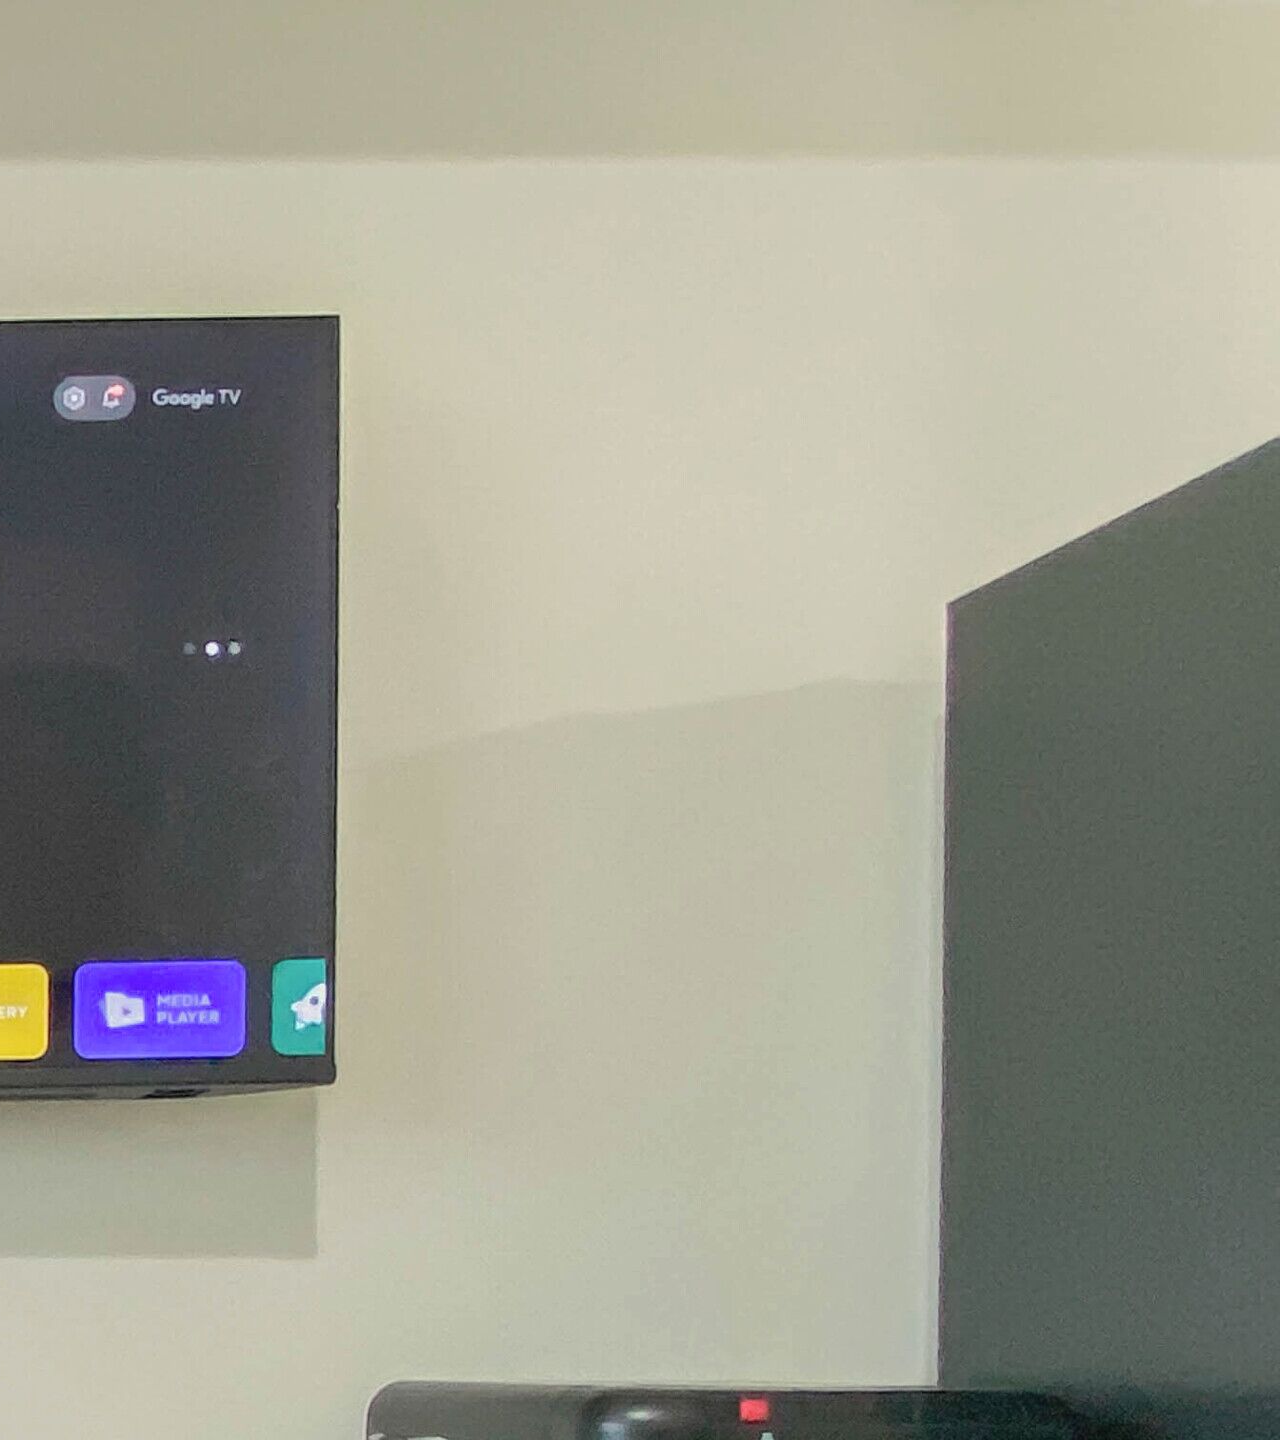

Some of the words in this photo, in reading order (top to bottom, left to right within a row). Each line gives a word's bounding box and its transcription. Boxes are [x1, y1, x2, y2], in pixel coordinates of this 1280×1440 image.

[152, 388, 214, 410] Google
[218, 388, 242, 405] TV
[155, 993, 212, 1007] MEDIA
[155, 1010, 220, 1025] PLAYER
